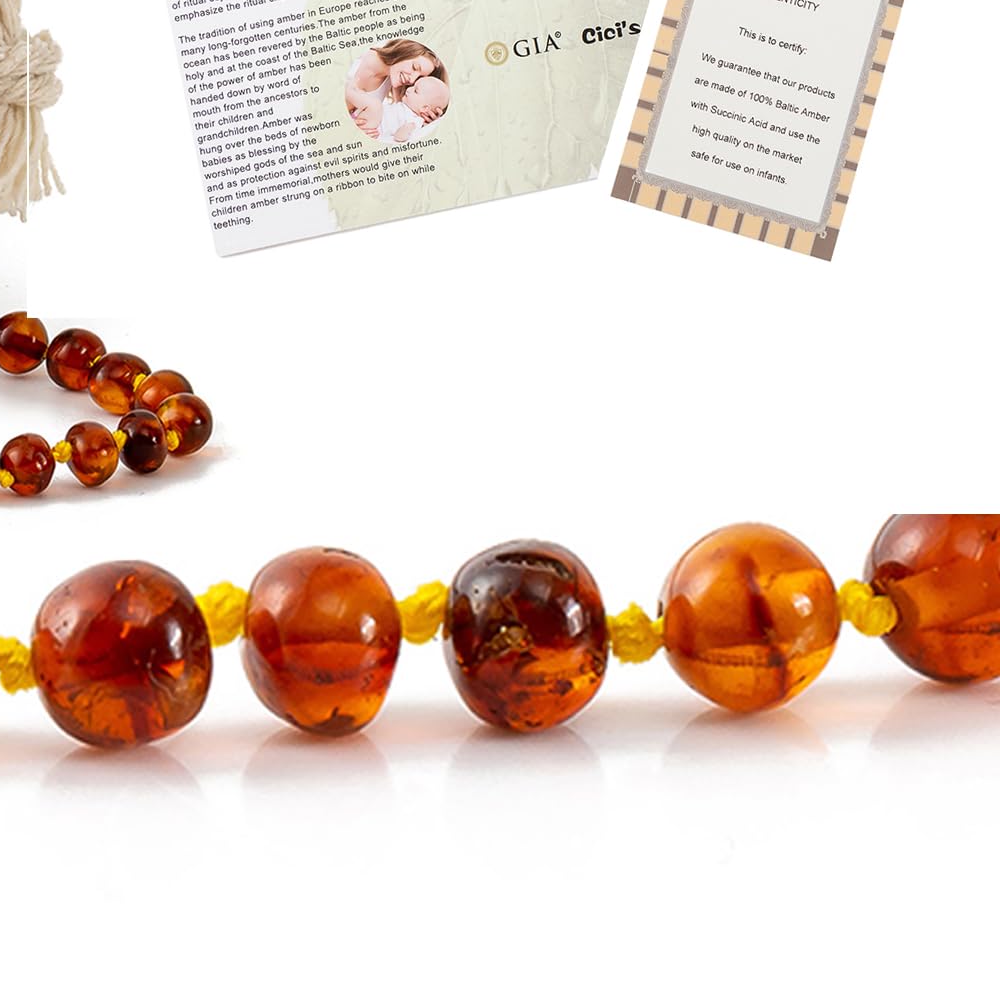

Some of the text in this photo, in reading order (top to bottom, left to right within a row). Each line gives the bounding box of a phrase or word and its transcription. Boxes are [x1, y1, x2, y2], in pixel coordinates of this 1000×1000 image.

[180, 45, 206, 57] many
[207, 32, 272, 51] long-forgotten
[338, 11, 367, 24] amber
[368, 7, 390, 17] from
[391, 3, 407, 13] the
[582, 20, 641, 44] Cici's
[738, 26, 808, 56] This is to certify:
[701, 52, 836, 100] We guarantee that our products
[293, 112, 313, 123] was
[694, 77, 831, 123] are made of 100% Baltic Amber
[690, 100, 821, 145] with Succinic Acid and use the
[206, 137, 442, 193] and as protection against evil spirits and misfortune.
[691, 124, 803, 165] high quality on the market
[690, 150, 786, 184] safe for use on infants.
[213, 216, 254, 230] teething.
